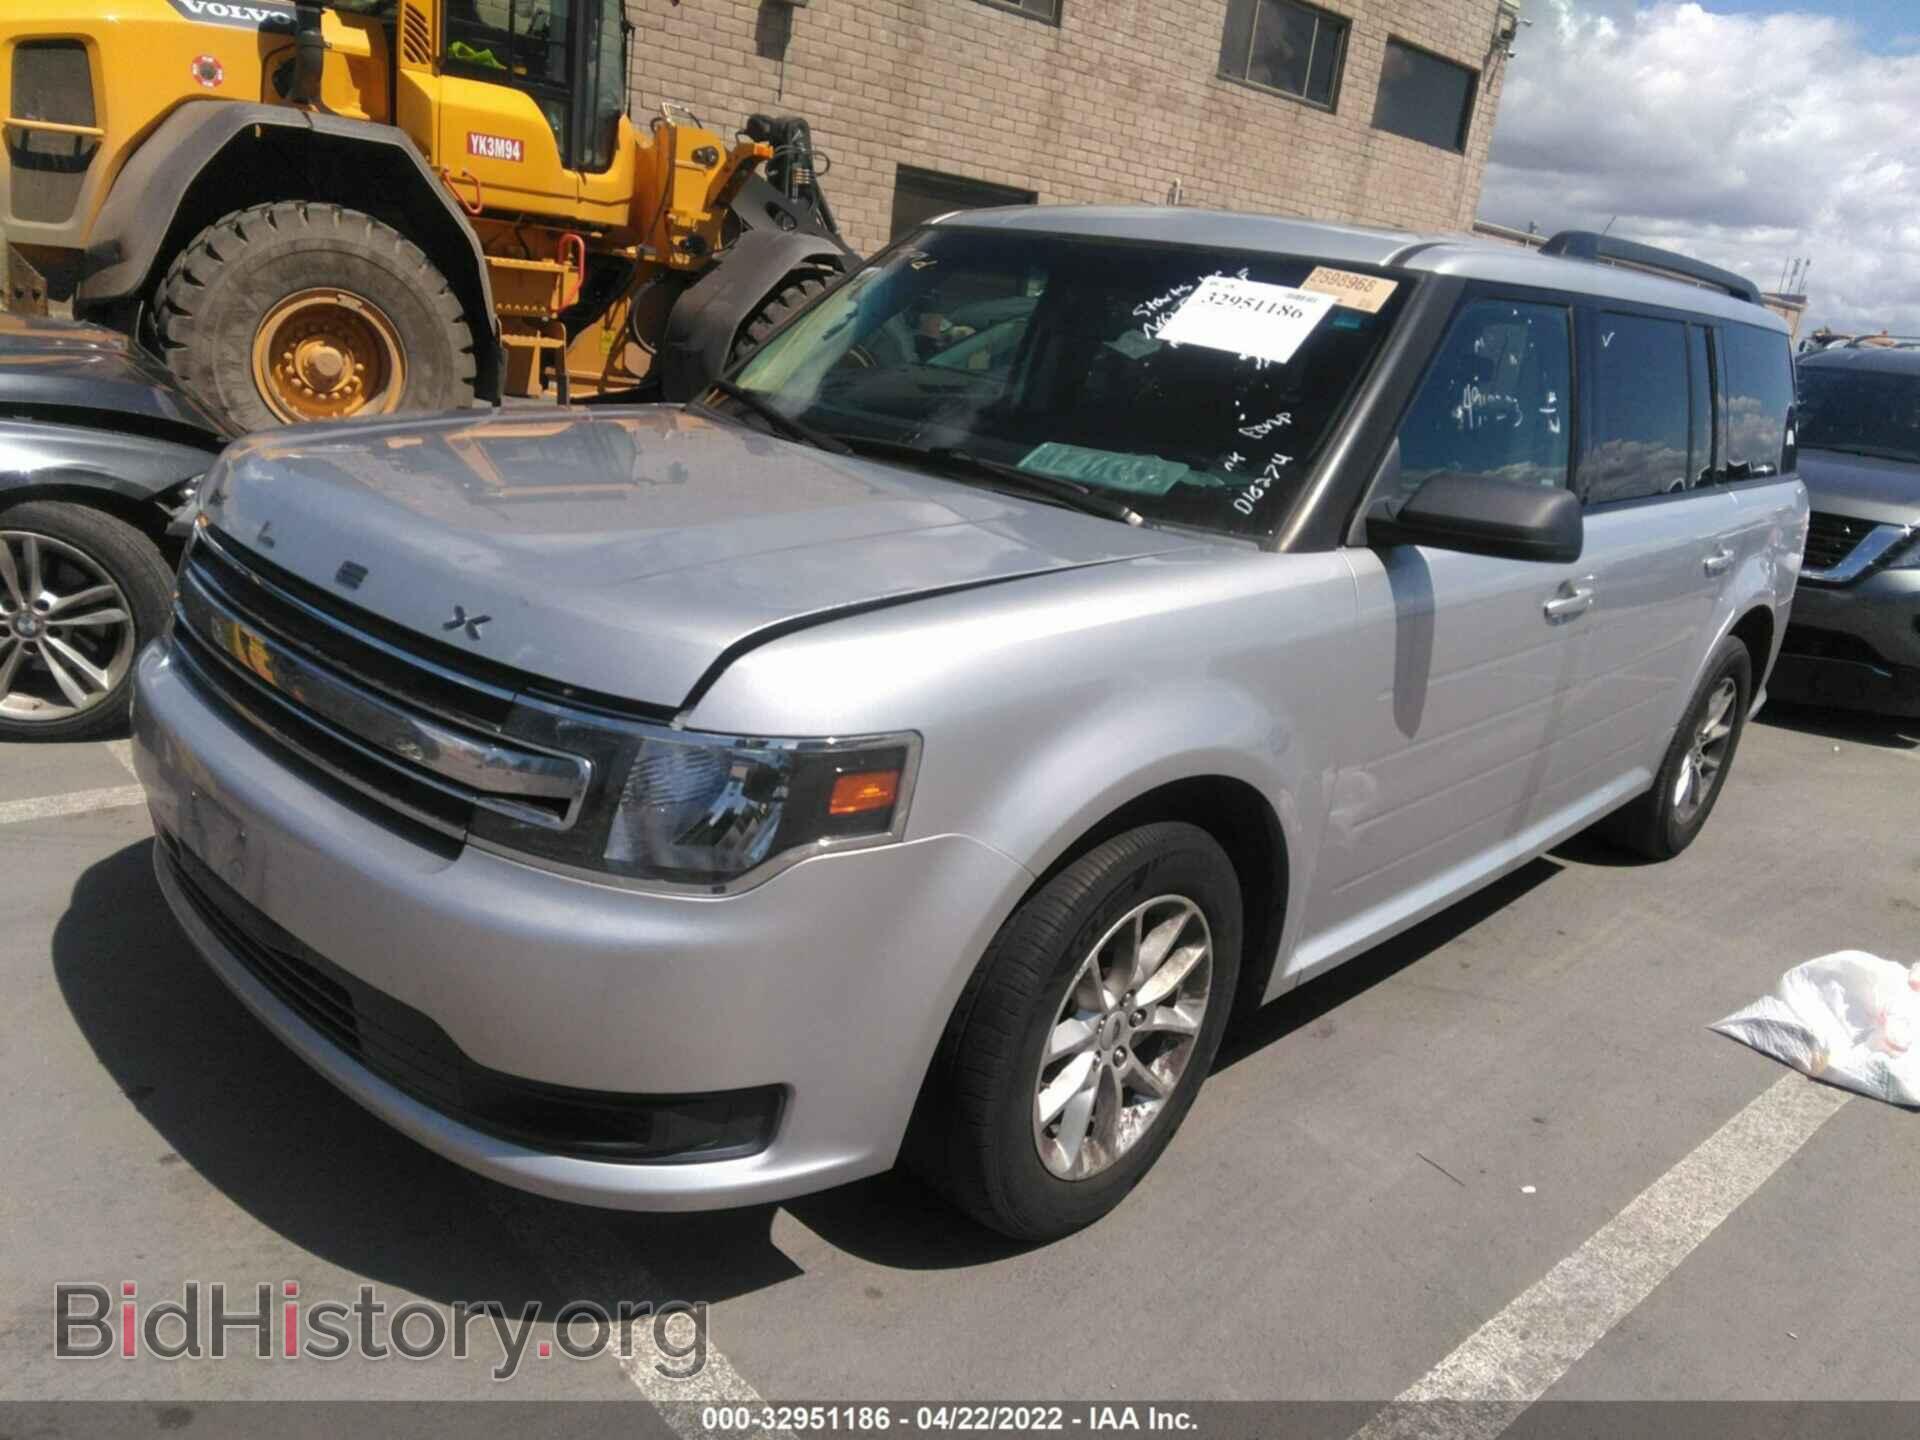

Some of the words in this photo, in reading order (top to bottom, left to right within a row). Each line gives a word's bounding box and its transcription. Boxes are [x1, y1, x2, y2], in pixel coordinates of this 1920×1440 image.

[181, 0, 291, 25] VOLVO
[470, 133, 521, 160] YK3M94
[1201, 291, 1304, 319] 32951186
